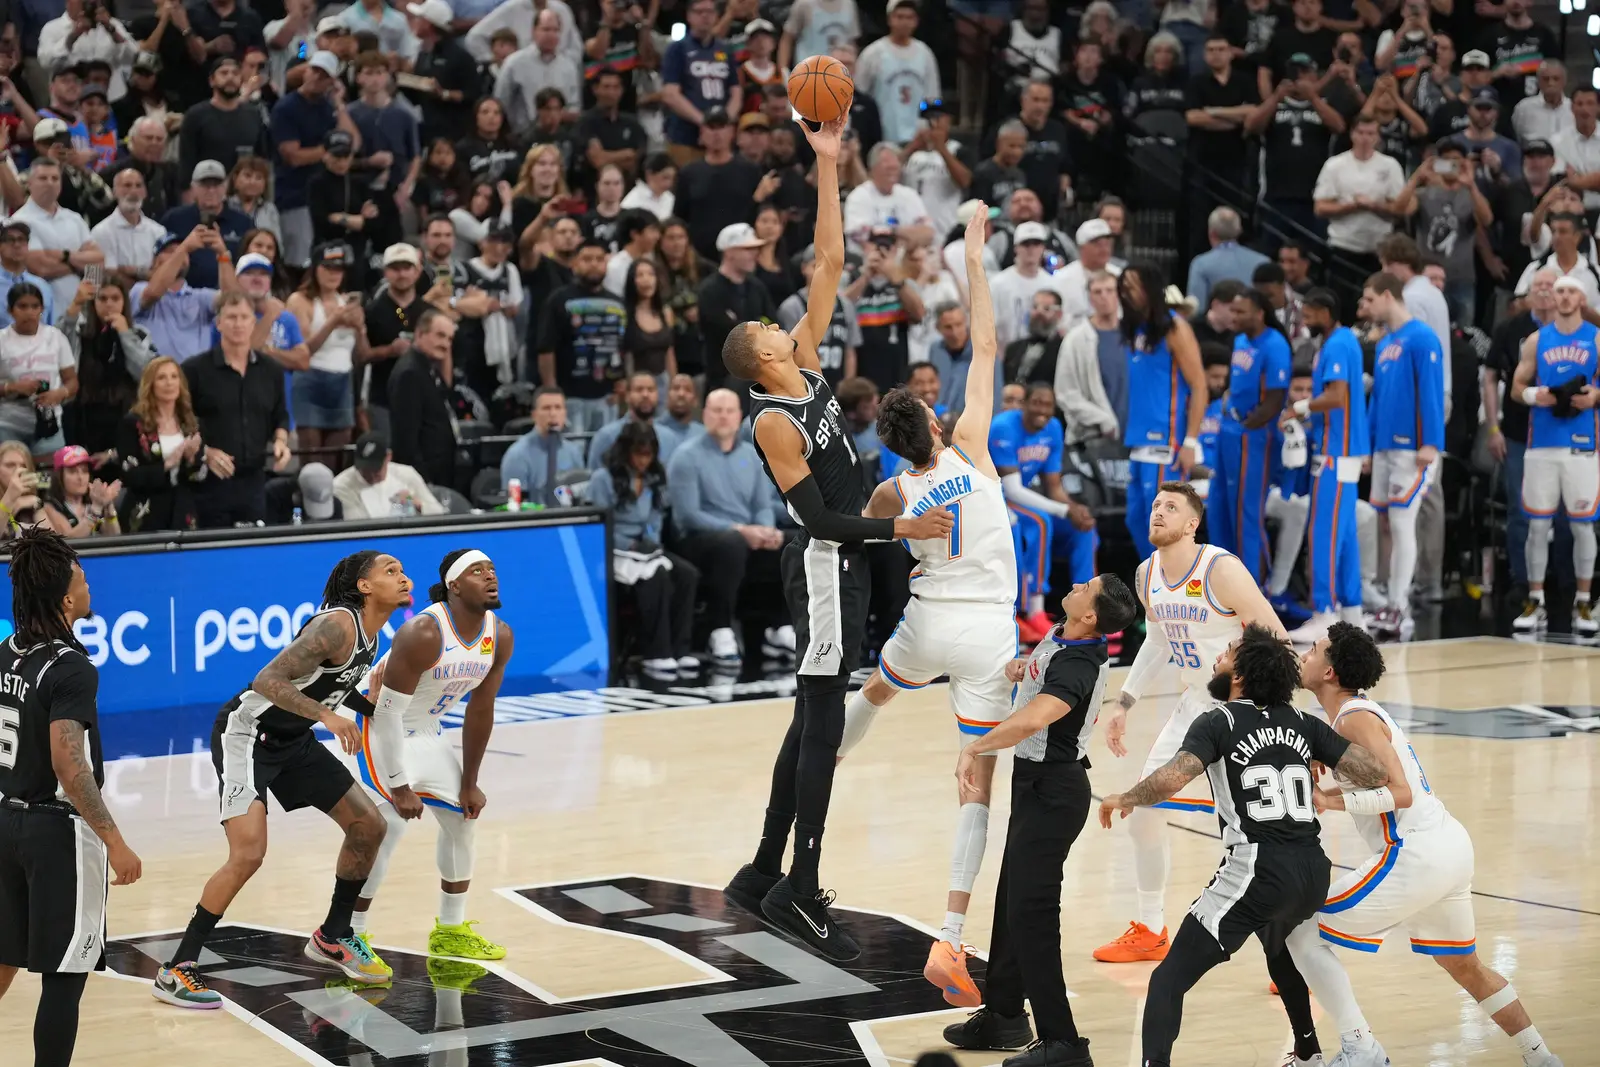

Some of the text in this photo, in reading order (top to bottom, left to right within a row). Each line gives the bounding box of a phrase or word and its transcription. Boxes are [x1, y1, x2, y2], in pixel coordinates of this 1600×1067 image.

[1543, 346, 1590, 366] THUNDER
[815, 395, 842, 450] SPUR
[842, 433, 858, 467] 1
[73, 601, 396, 672] BC peac
[1164, 622, 1190, 640] CITY
[1168, 639, 1203, 670] 55
[428, 692, 458, 717] 5
[1230, 726, 1311, 766] CHAMPAGNIE
[1240, 764, 1315, 823] 30
